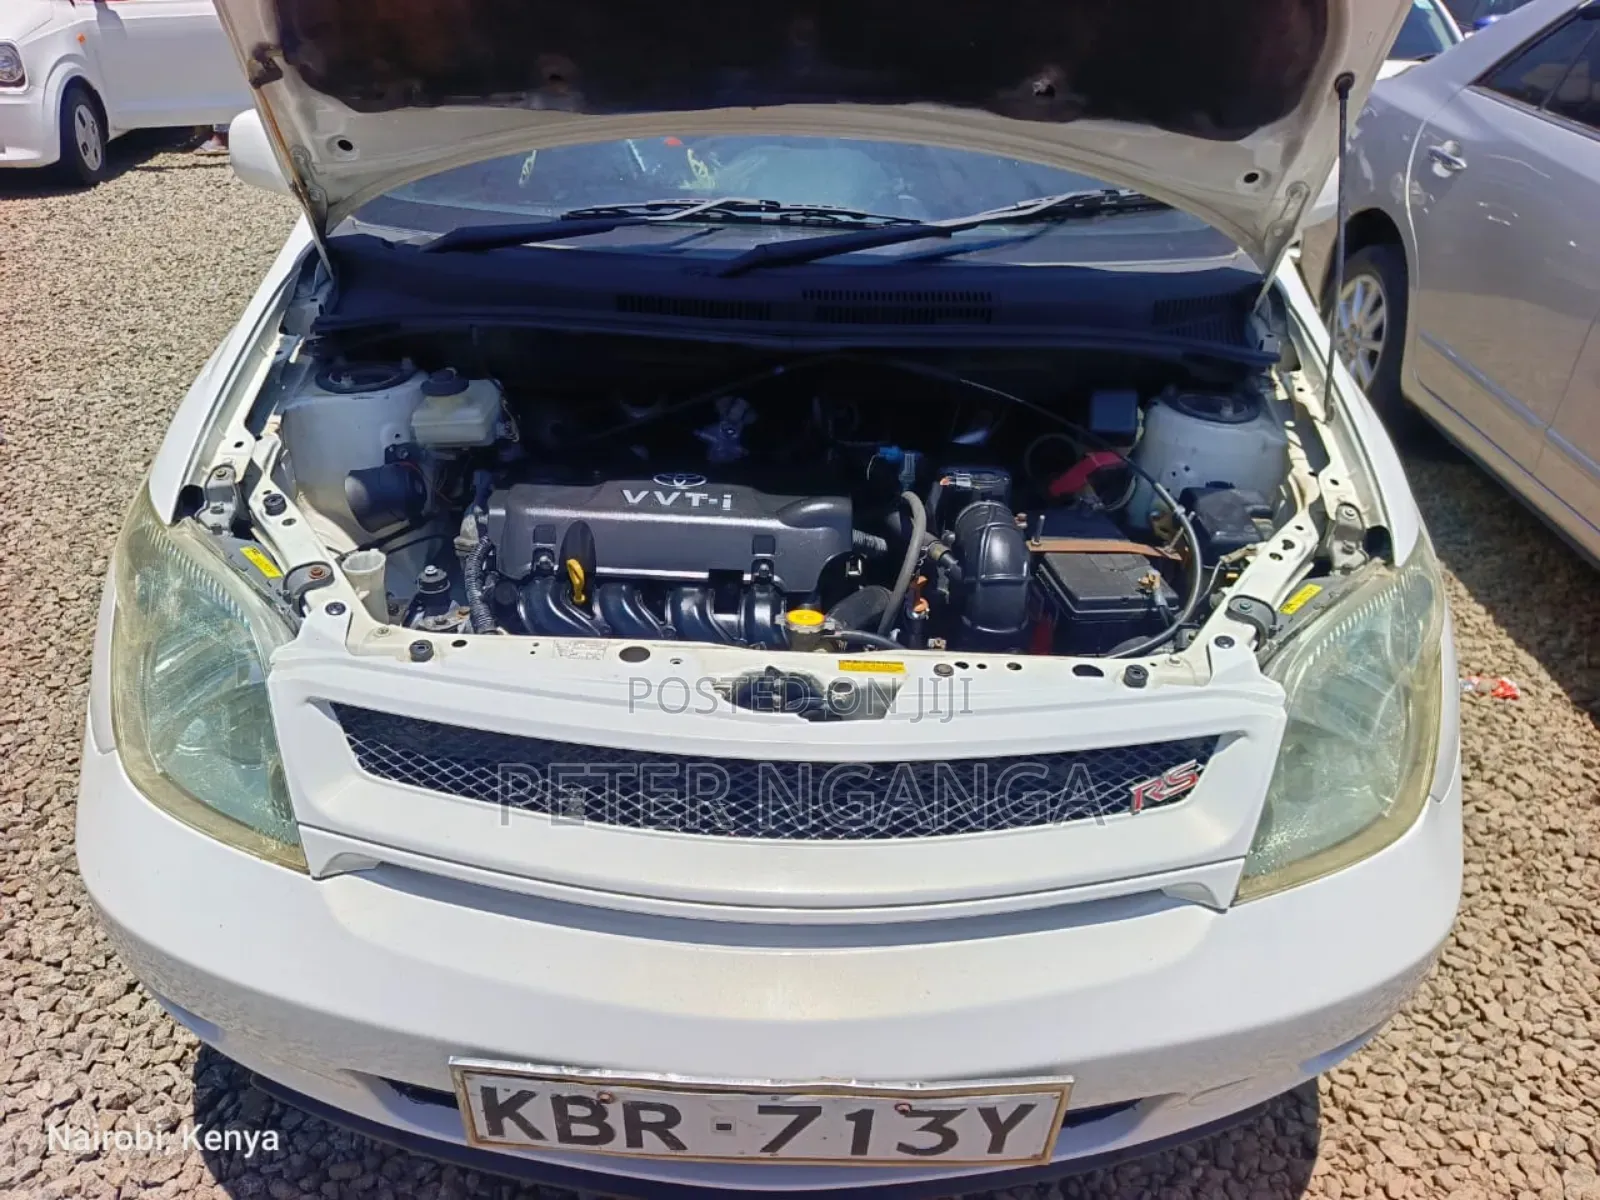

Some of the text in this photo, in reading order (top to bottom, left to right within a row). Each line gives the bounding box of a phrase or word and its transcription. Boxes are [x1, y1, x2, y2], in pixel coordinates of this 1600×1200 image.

[622, 489, 732, 511] VVT-i
[1130, 759, 1204, 815] RS
[479, 1085, 1038, 1157] KBR 713Y
